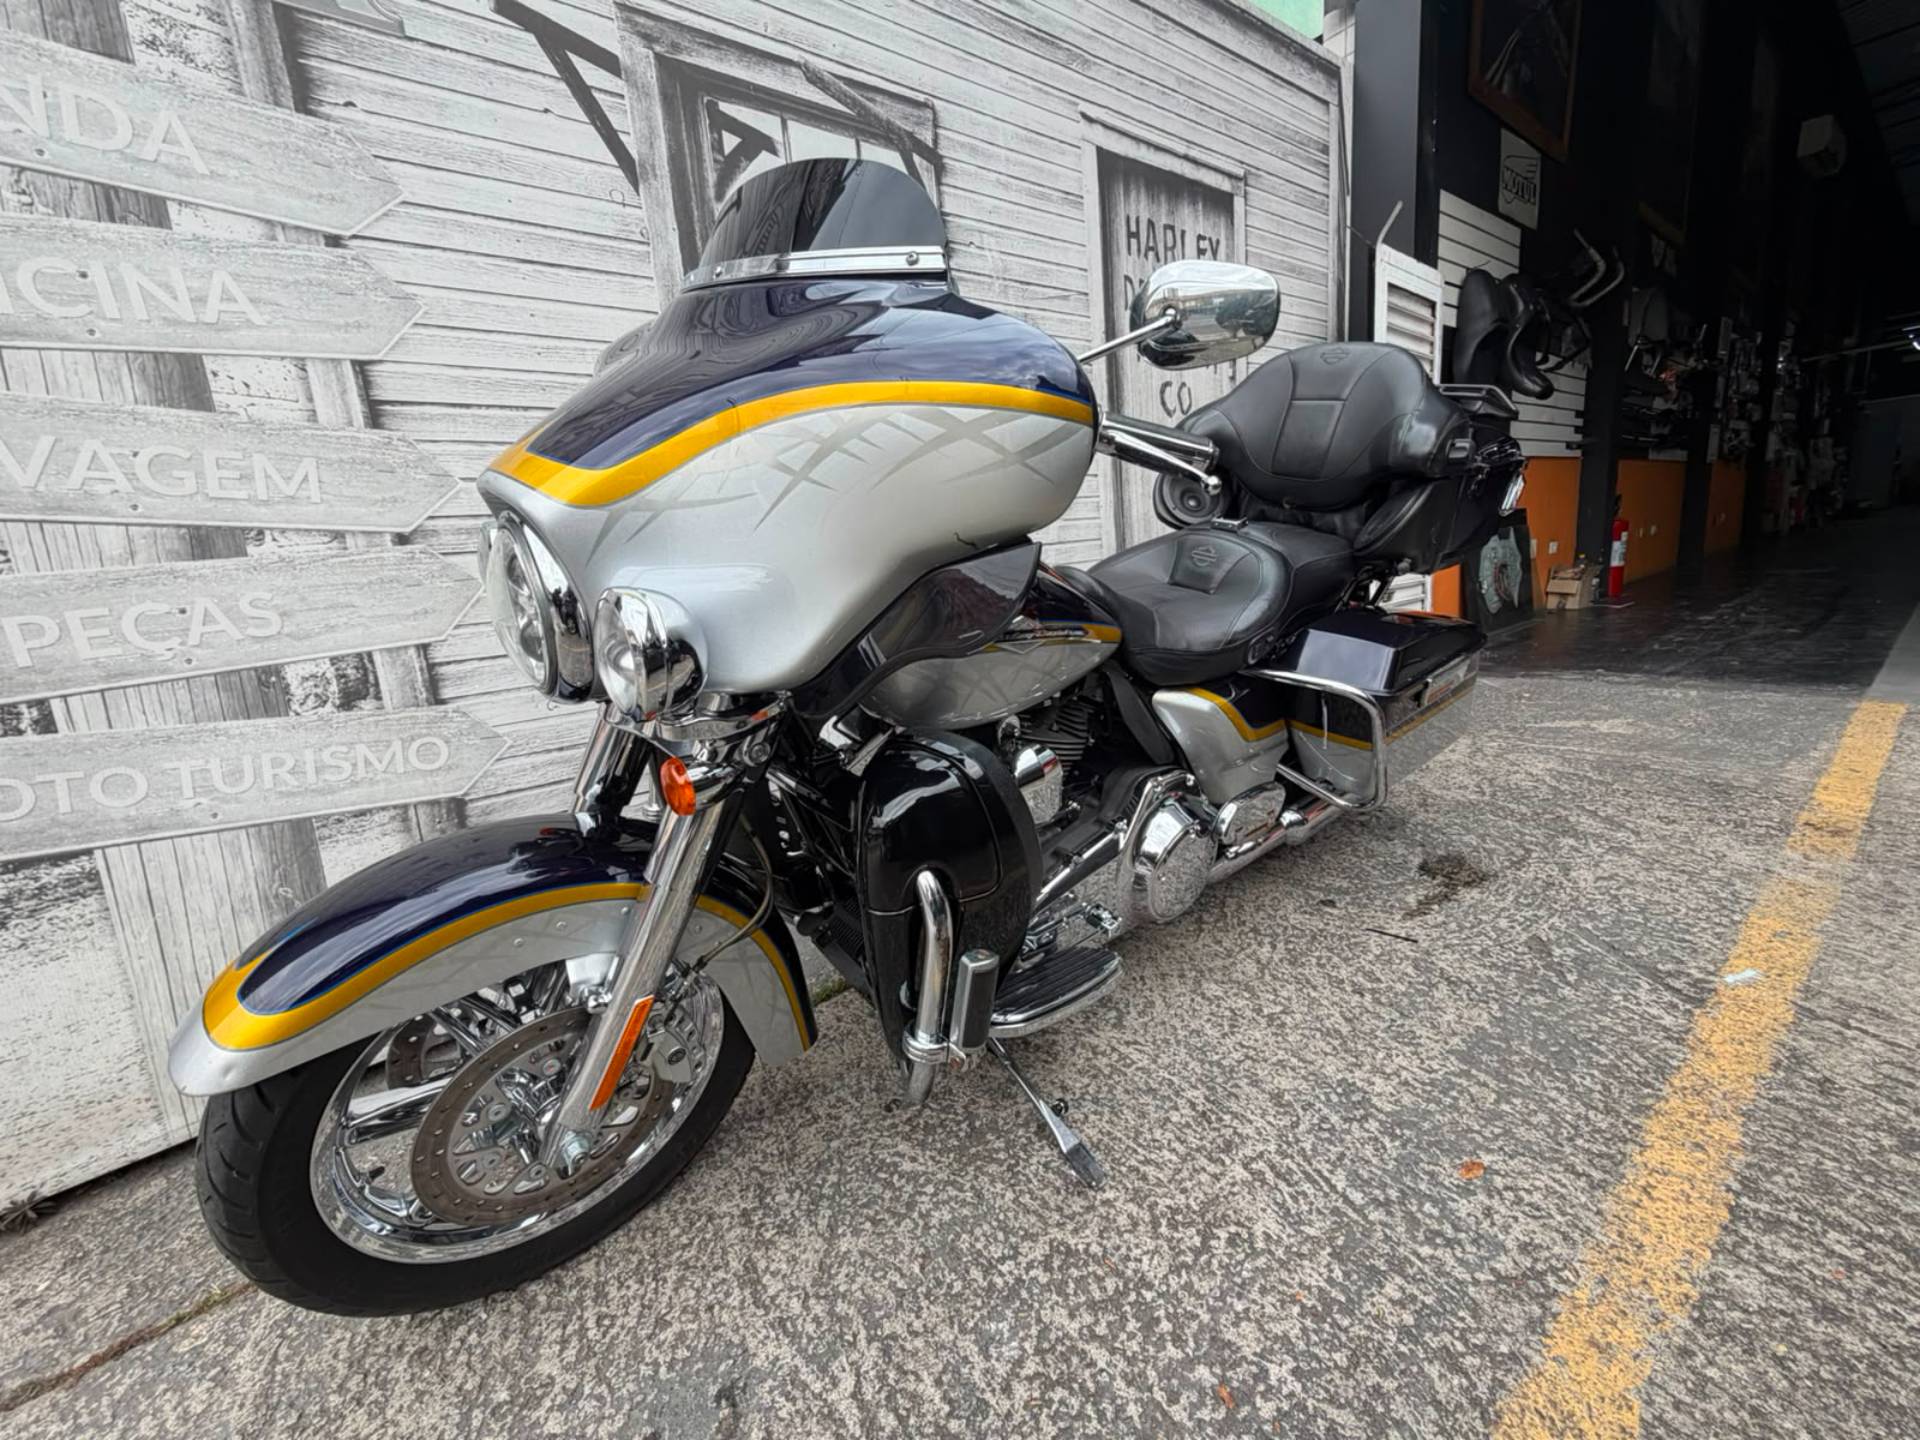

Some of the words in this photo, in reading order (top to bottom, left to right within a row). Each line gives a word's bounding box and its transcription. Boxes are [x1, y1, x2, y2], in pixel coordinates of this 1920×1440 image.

[0, 74, 210, 175] NDA
[1126, 214, 1220, 263] HARLEY
[1159, 380, 1192, 418] CO
[0, 435, 321, 504] VAGEM
[1, 591, 283, 668] PEÇAS
[0, 766, 149, 821] OTO
[164, 735, 450, 800] TURISMO
